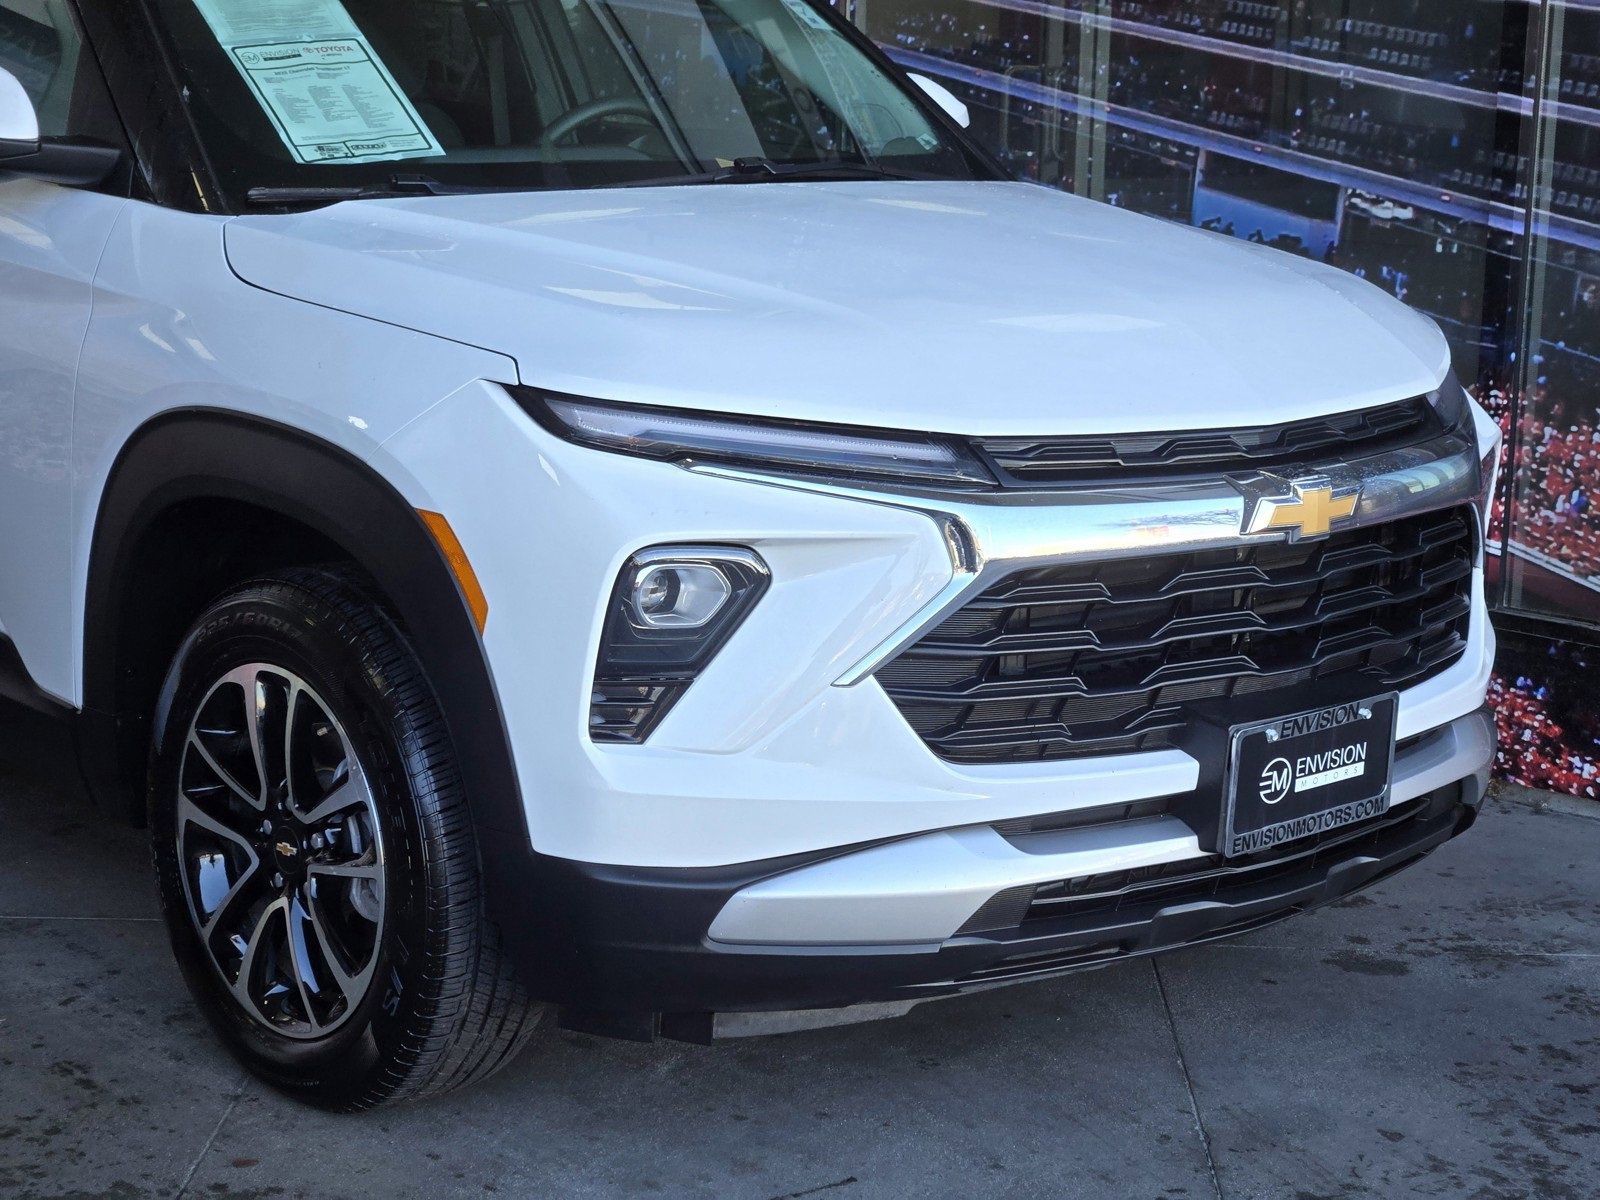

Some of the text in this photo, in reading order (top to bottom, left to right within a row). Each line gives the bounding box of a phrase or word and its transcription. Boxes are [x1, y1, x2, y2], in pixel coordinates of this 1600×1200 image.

[259, 47, 301, 58] ENVISION
[314, 45, 354, 54] TOYOTA
[1280, 702, 1360, 739] ENVISION
[1295, 742, 1367, 777] ENVISION
[1300, 766, 1359, 788] MOTORS
[1233, 796, 1385, 854] ENVISIONMOTORS.COM
